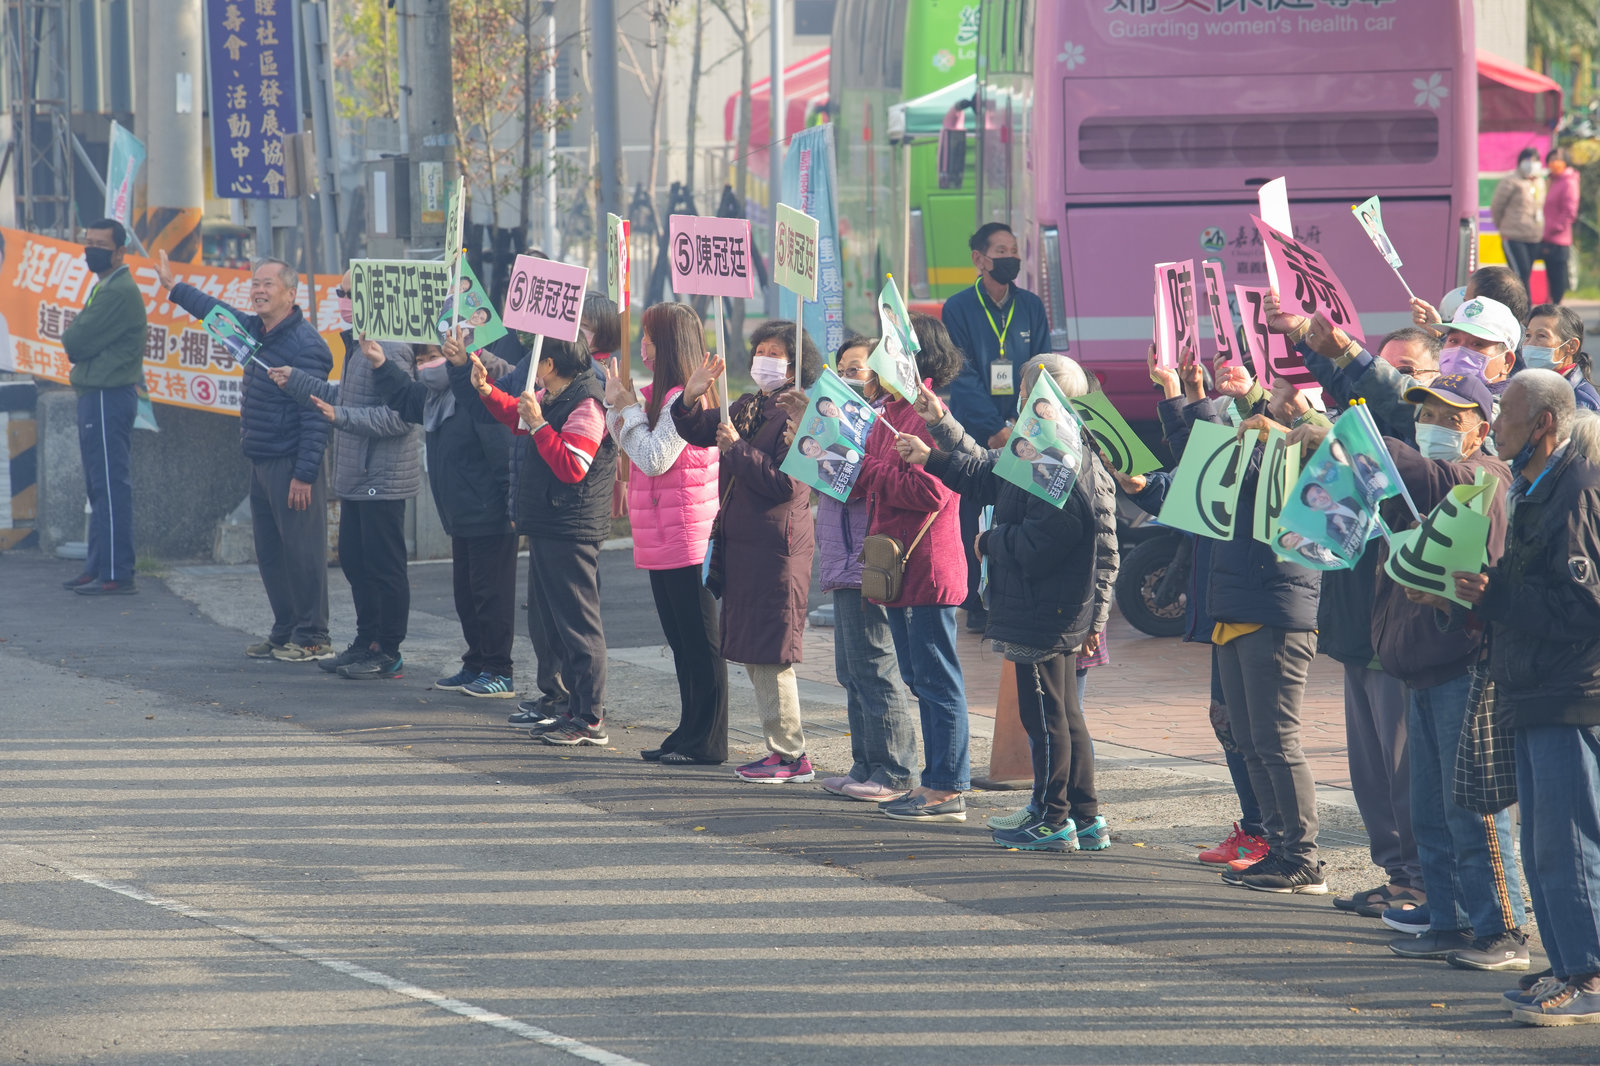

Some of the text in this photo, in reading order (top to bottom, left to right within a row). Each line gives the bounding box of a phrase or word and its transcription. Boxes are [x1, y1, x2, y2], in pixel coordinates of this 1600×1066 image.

[1108, 15, 1396, 40] Guarding women's health car
[222, 0, 252, 194] 壽會、活動中心
[996, 371, 1008, 381] 66
